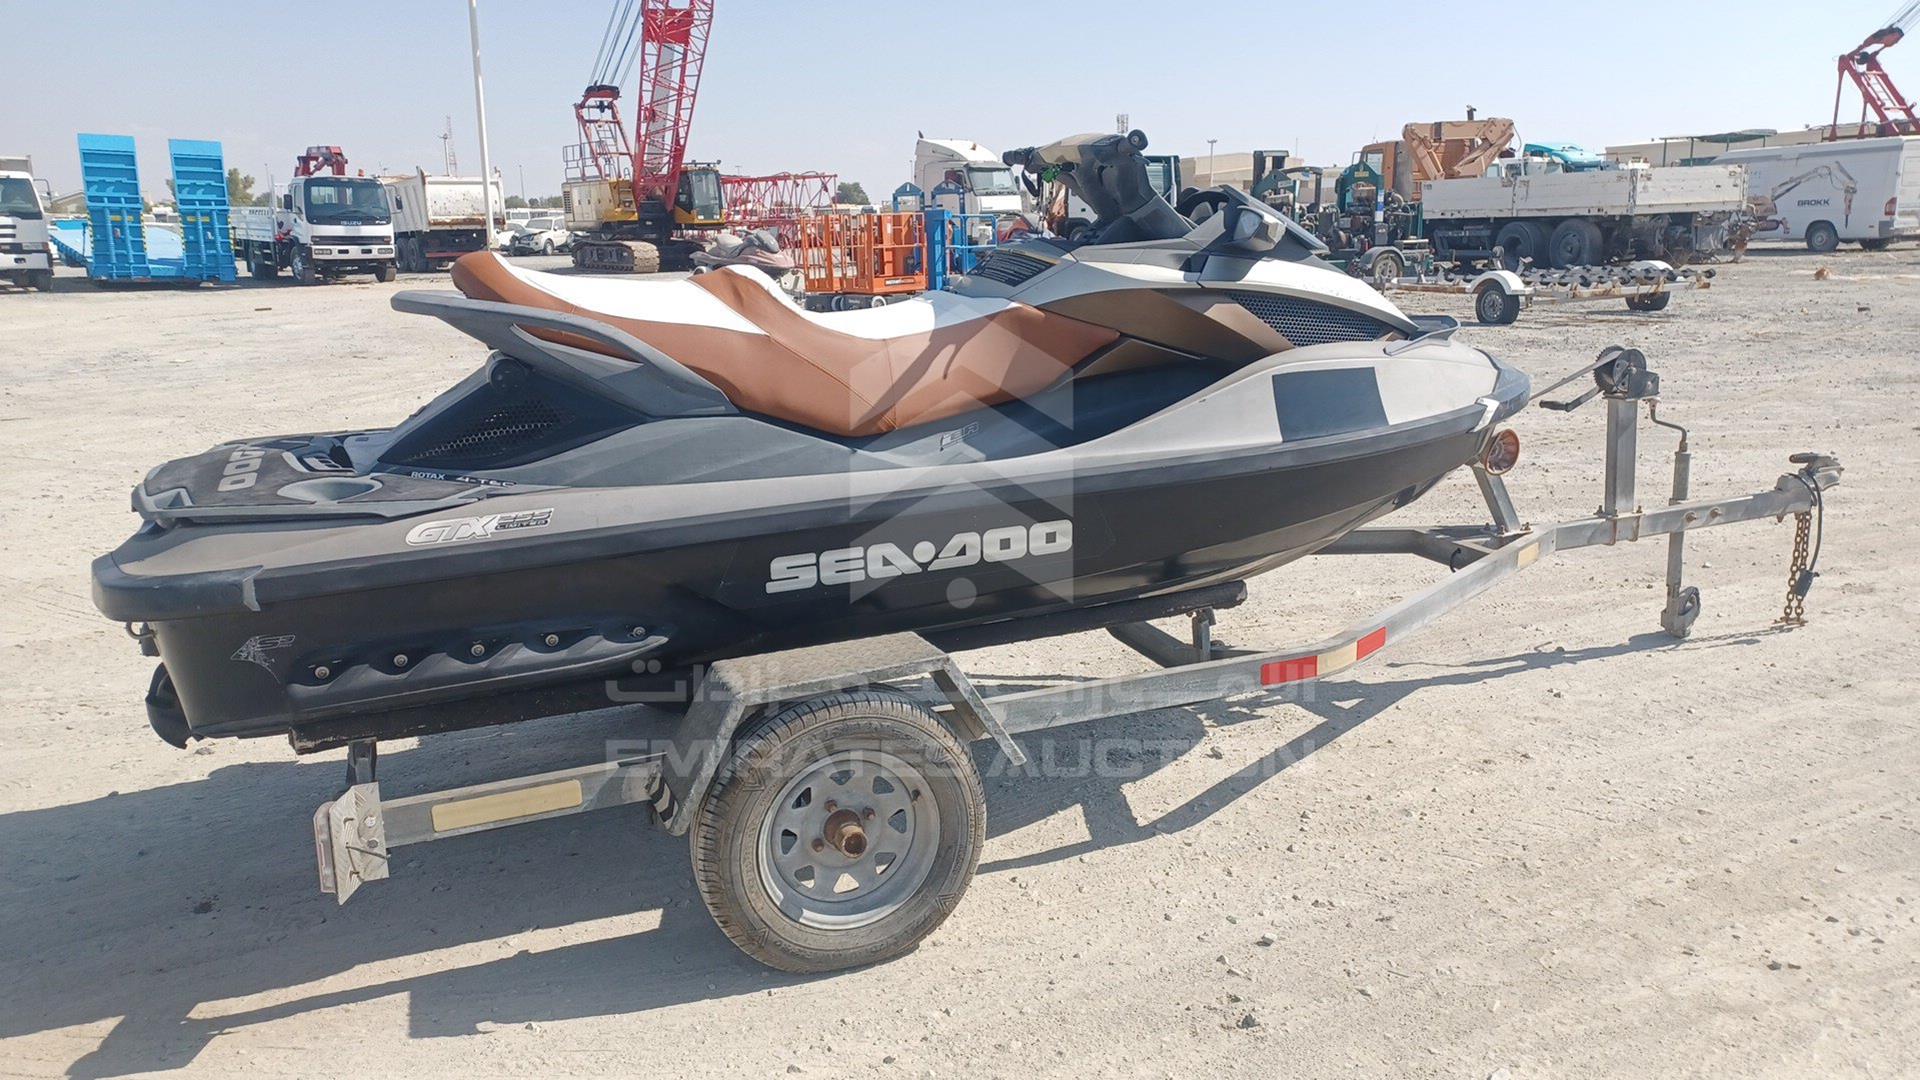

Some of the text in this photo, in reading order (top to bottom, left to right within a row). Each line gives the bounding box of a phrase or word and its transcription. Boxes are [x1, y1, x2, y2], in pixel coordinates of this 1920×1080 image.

[1797, 199, 1830, 207] BROKK
[411, 471, 446, 480] ROTAX
[406, 514, 500, 546] GTX
